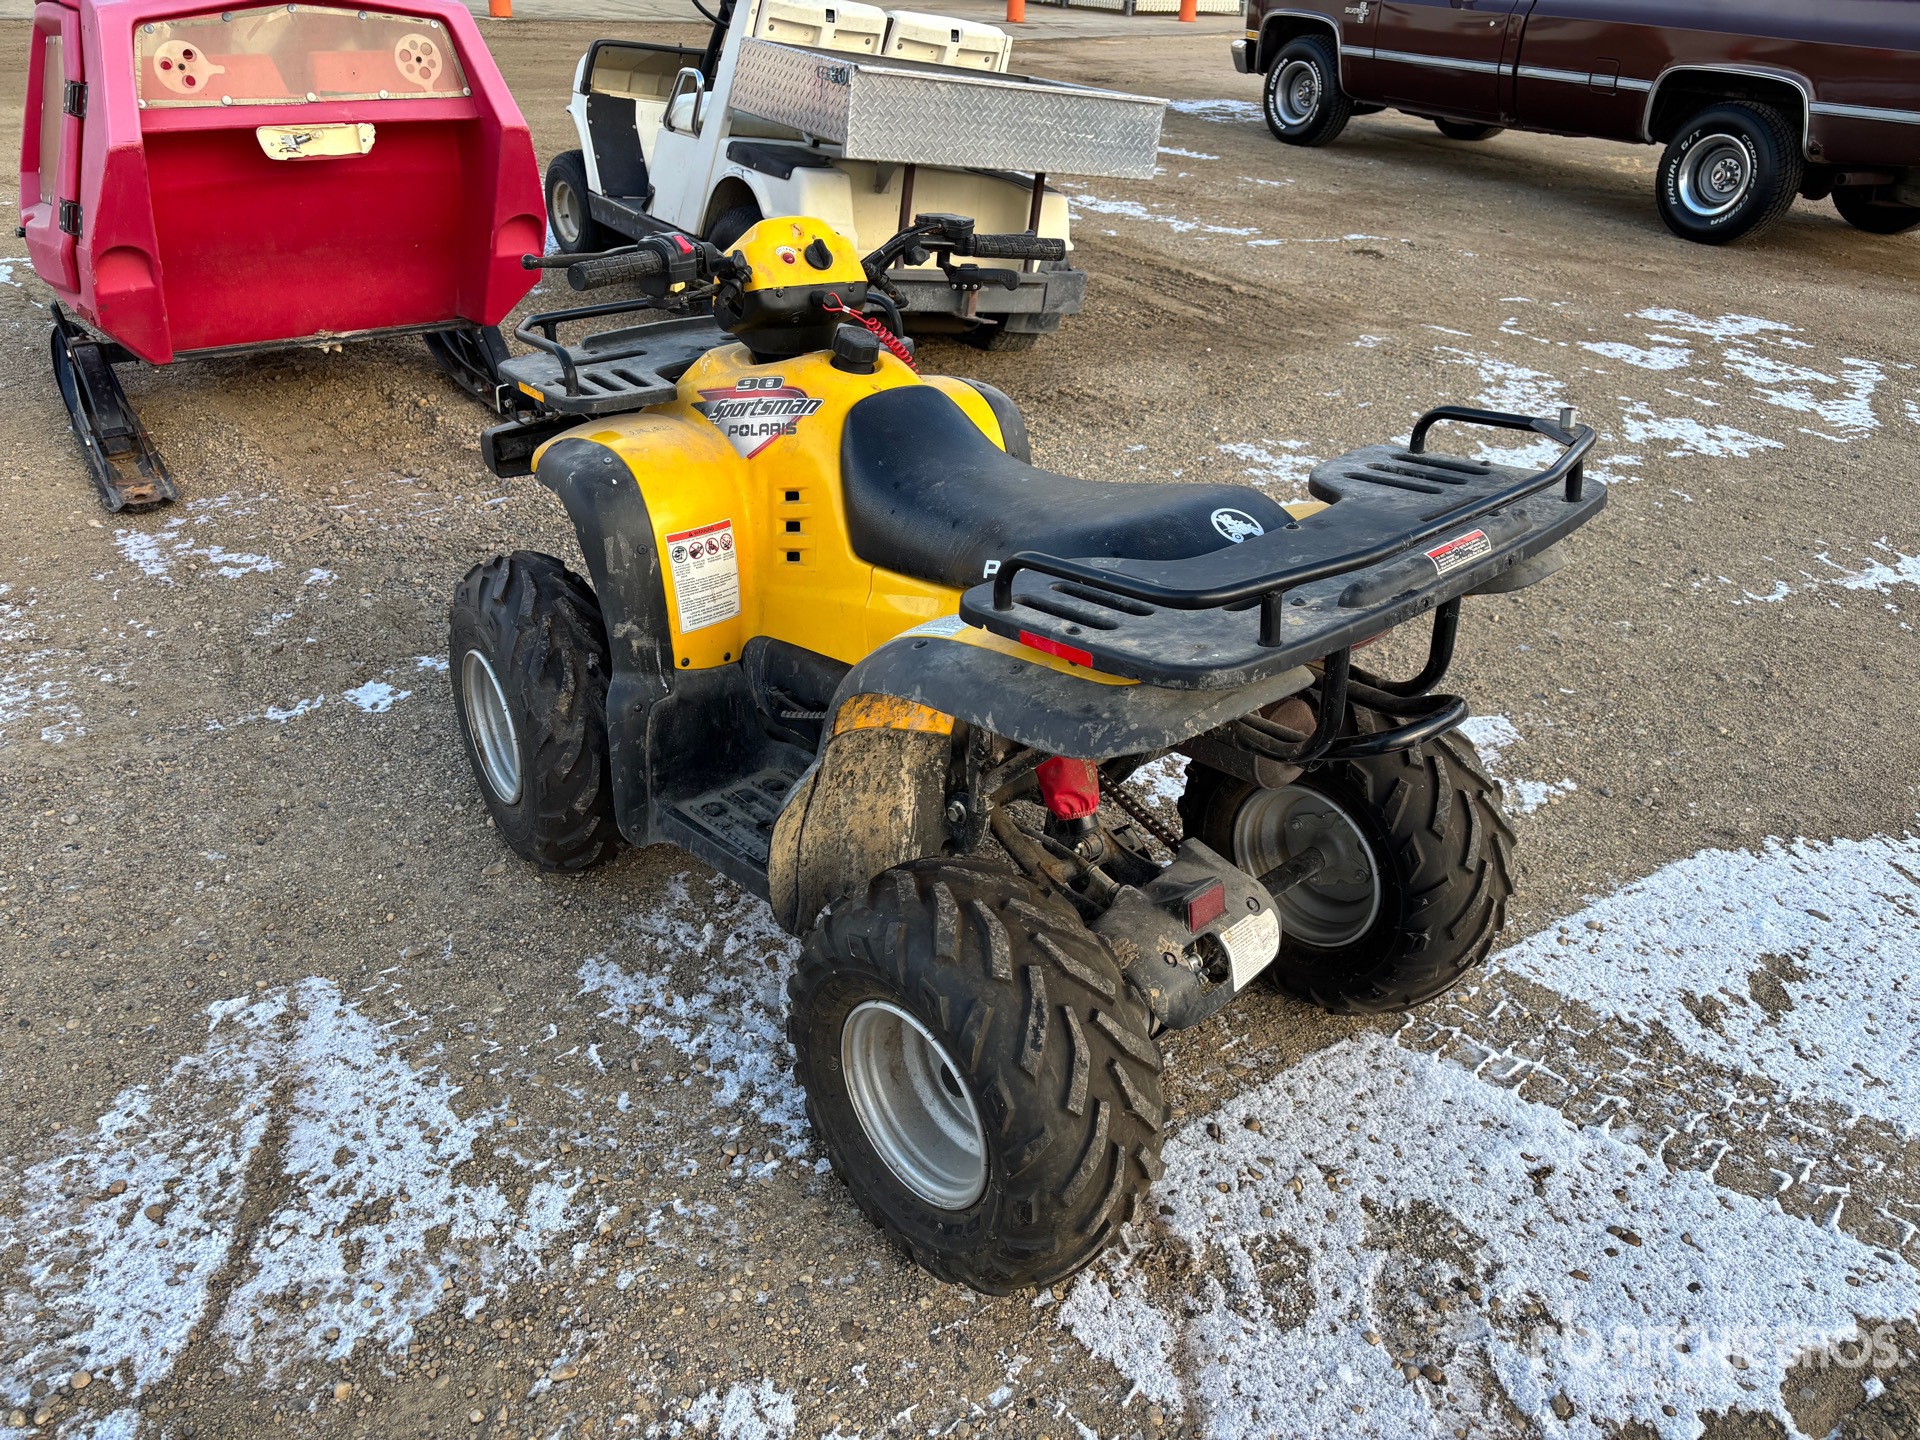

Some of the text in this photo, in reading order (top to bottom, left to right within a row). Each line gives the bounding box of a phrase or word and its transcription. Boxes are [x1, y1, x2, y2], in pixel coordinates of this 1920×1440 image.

[1268, 58, 1288, 130] COOPER COBRA
[1311, 60, 1322, 96] RADIAL
[1667, 129, 1701, 205] RADIAL G/T
[1710, 133, 1758, 226] COOPER COBRA
[735, 376, 785, 392] 90
[707, 397, 825, 425] Sportsman
[727, 421, 798, 437] POLARIS
